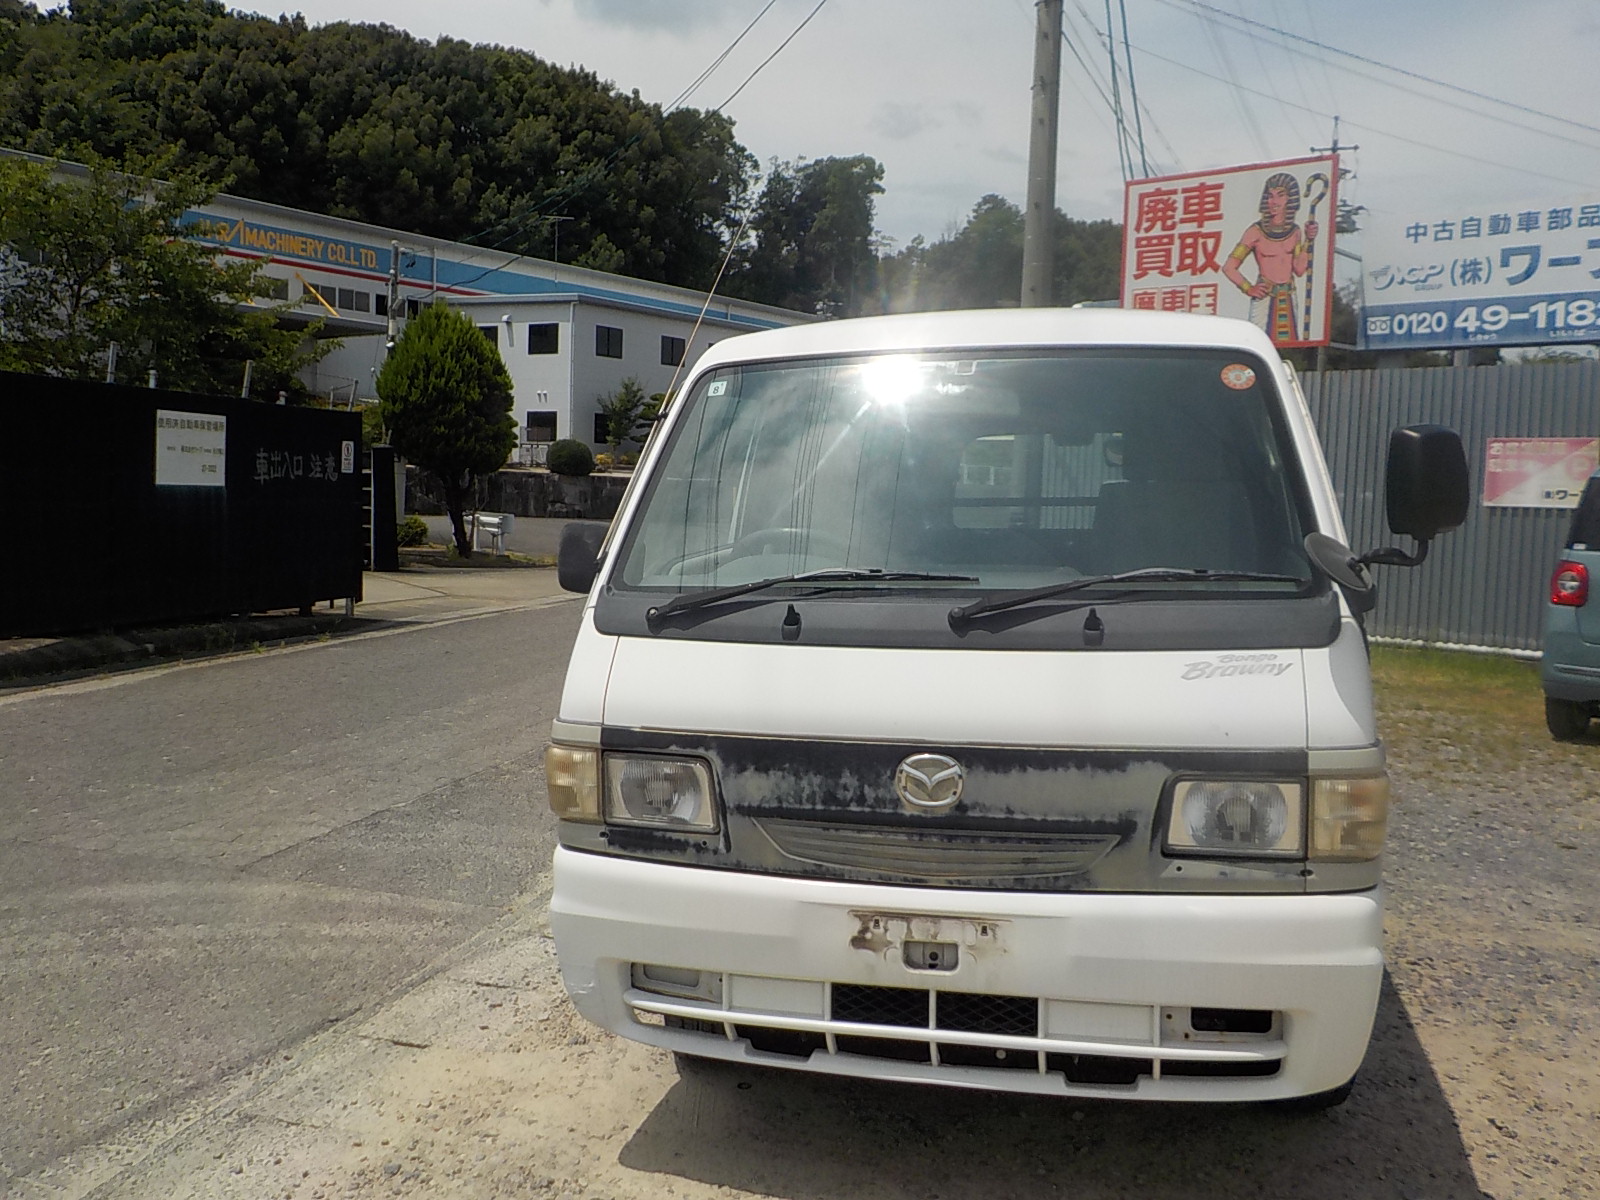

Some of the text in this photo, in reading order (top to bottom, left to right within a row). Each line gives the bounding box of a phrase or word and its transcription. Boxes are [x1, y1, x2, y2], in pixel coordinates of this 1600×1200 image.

[1134, 181, 1225, 233] 廃車
[1405, 204, 1600, 243] 中古自動車部品
[245, 226, 325, 259] MACHINERY
[1133, 230, 1223, 280] 買取
[1393, 311, 1448, 335] 0120
[253, 447, 304, 485] 車出入口
[308, 451, 338, 482] 注意
[1180, 661, 1294, 681] Brawny
[1215, 653, 1278, 664] Bongo
